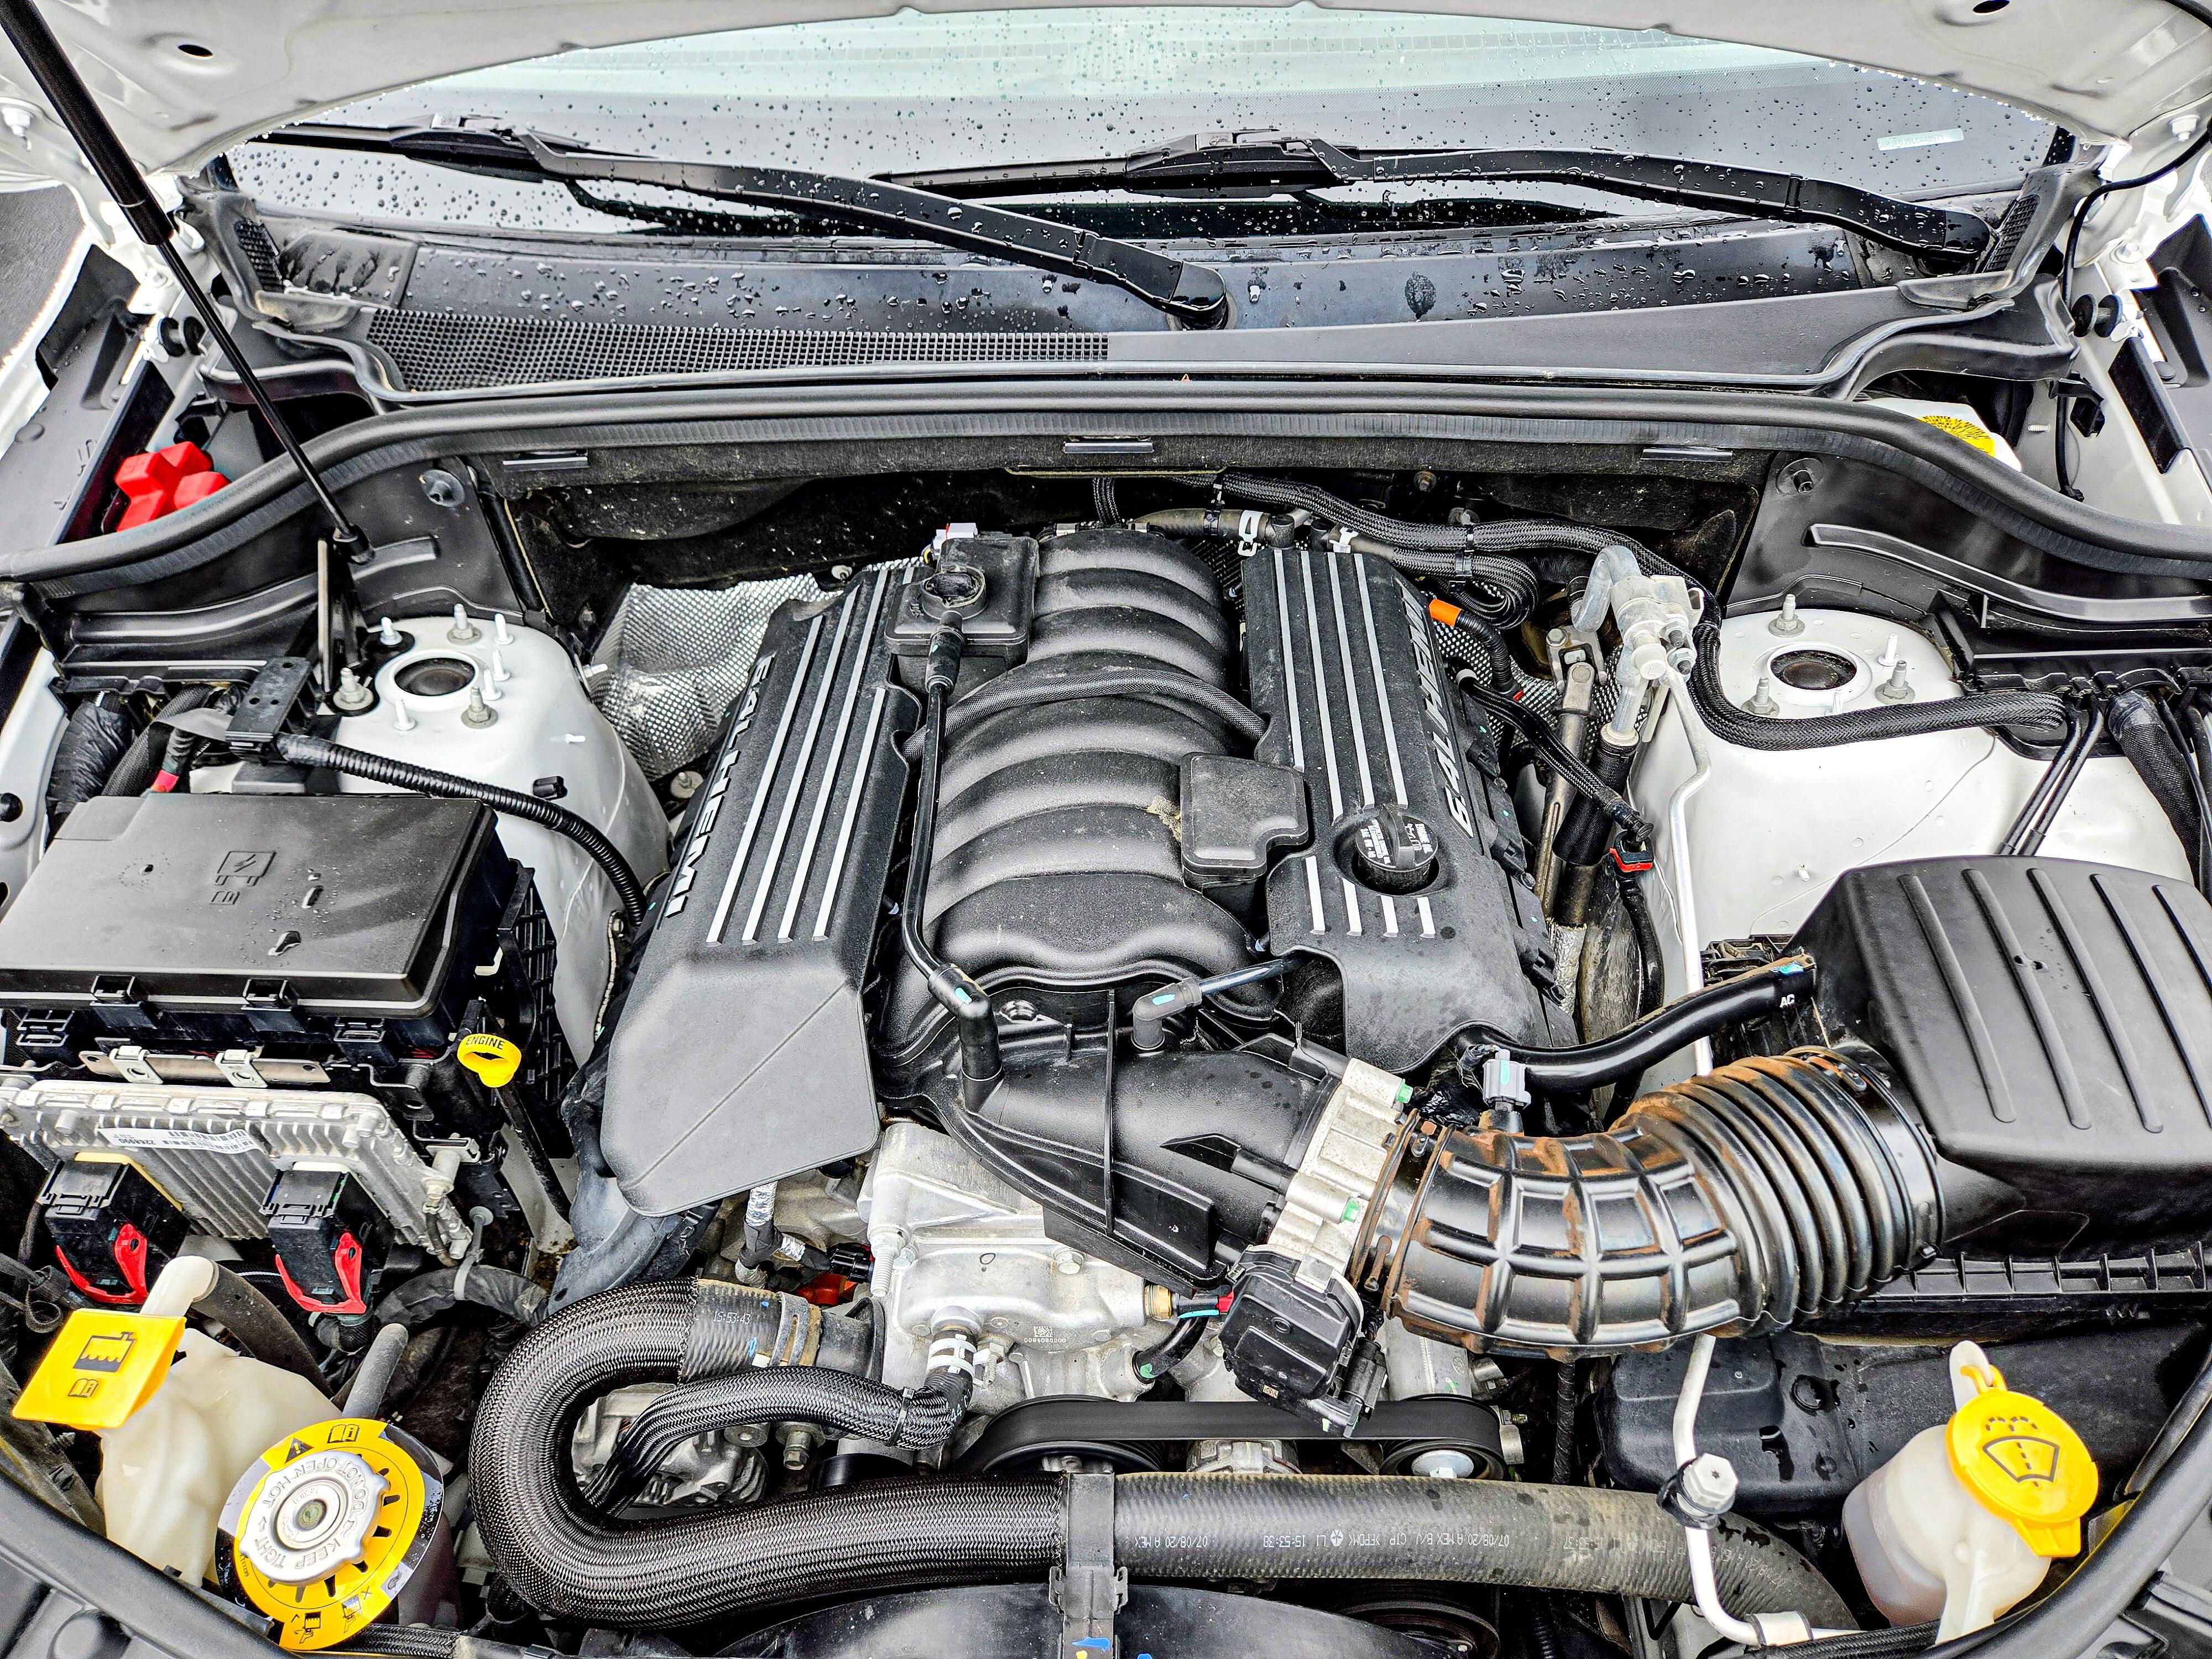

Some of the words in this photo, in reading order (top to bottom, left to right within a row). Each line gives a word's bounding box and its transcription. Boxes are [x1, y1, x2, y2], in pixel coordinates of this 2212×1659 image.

[1400, 585, 1449, 733] HEMI
[665, 750, 742, 919] HEMI
[1360, 828, 1371, 838] SAE
[1415, 823, 1431, 843] ENGINE
[1421, 843, 1433, 854] OIL
[1779, 994, 1796, 1008] AC
[466, 1036, 505, 1050] ENGINE
[713, 1311, 752, 1324] 15:53:43
[338, 1461, 364, 1486] NOT
[352, 1489, 368, 1515] DO
[1134, 1536, 1152, 1548] MEX
[1154, 1536, 1160, 1548] A
[1165, 1535, 1208, 1548] 07/08/20
[1262, 1534, 1306, 1548] 15:53:38
[1437, 1532, 1455, 1545] MEX
[254, 1536, 286, 1569] TIGHT
[294, 1538, 341, 1570] KEEP
